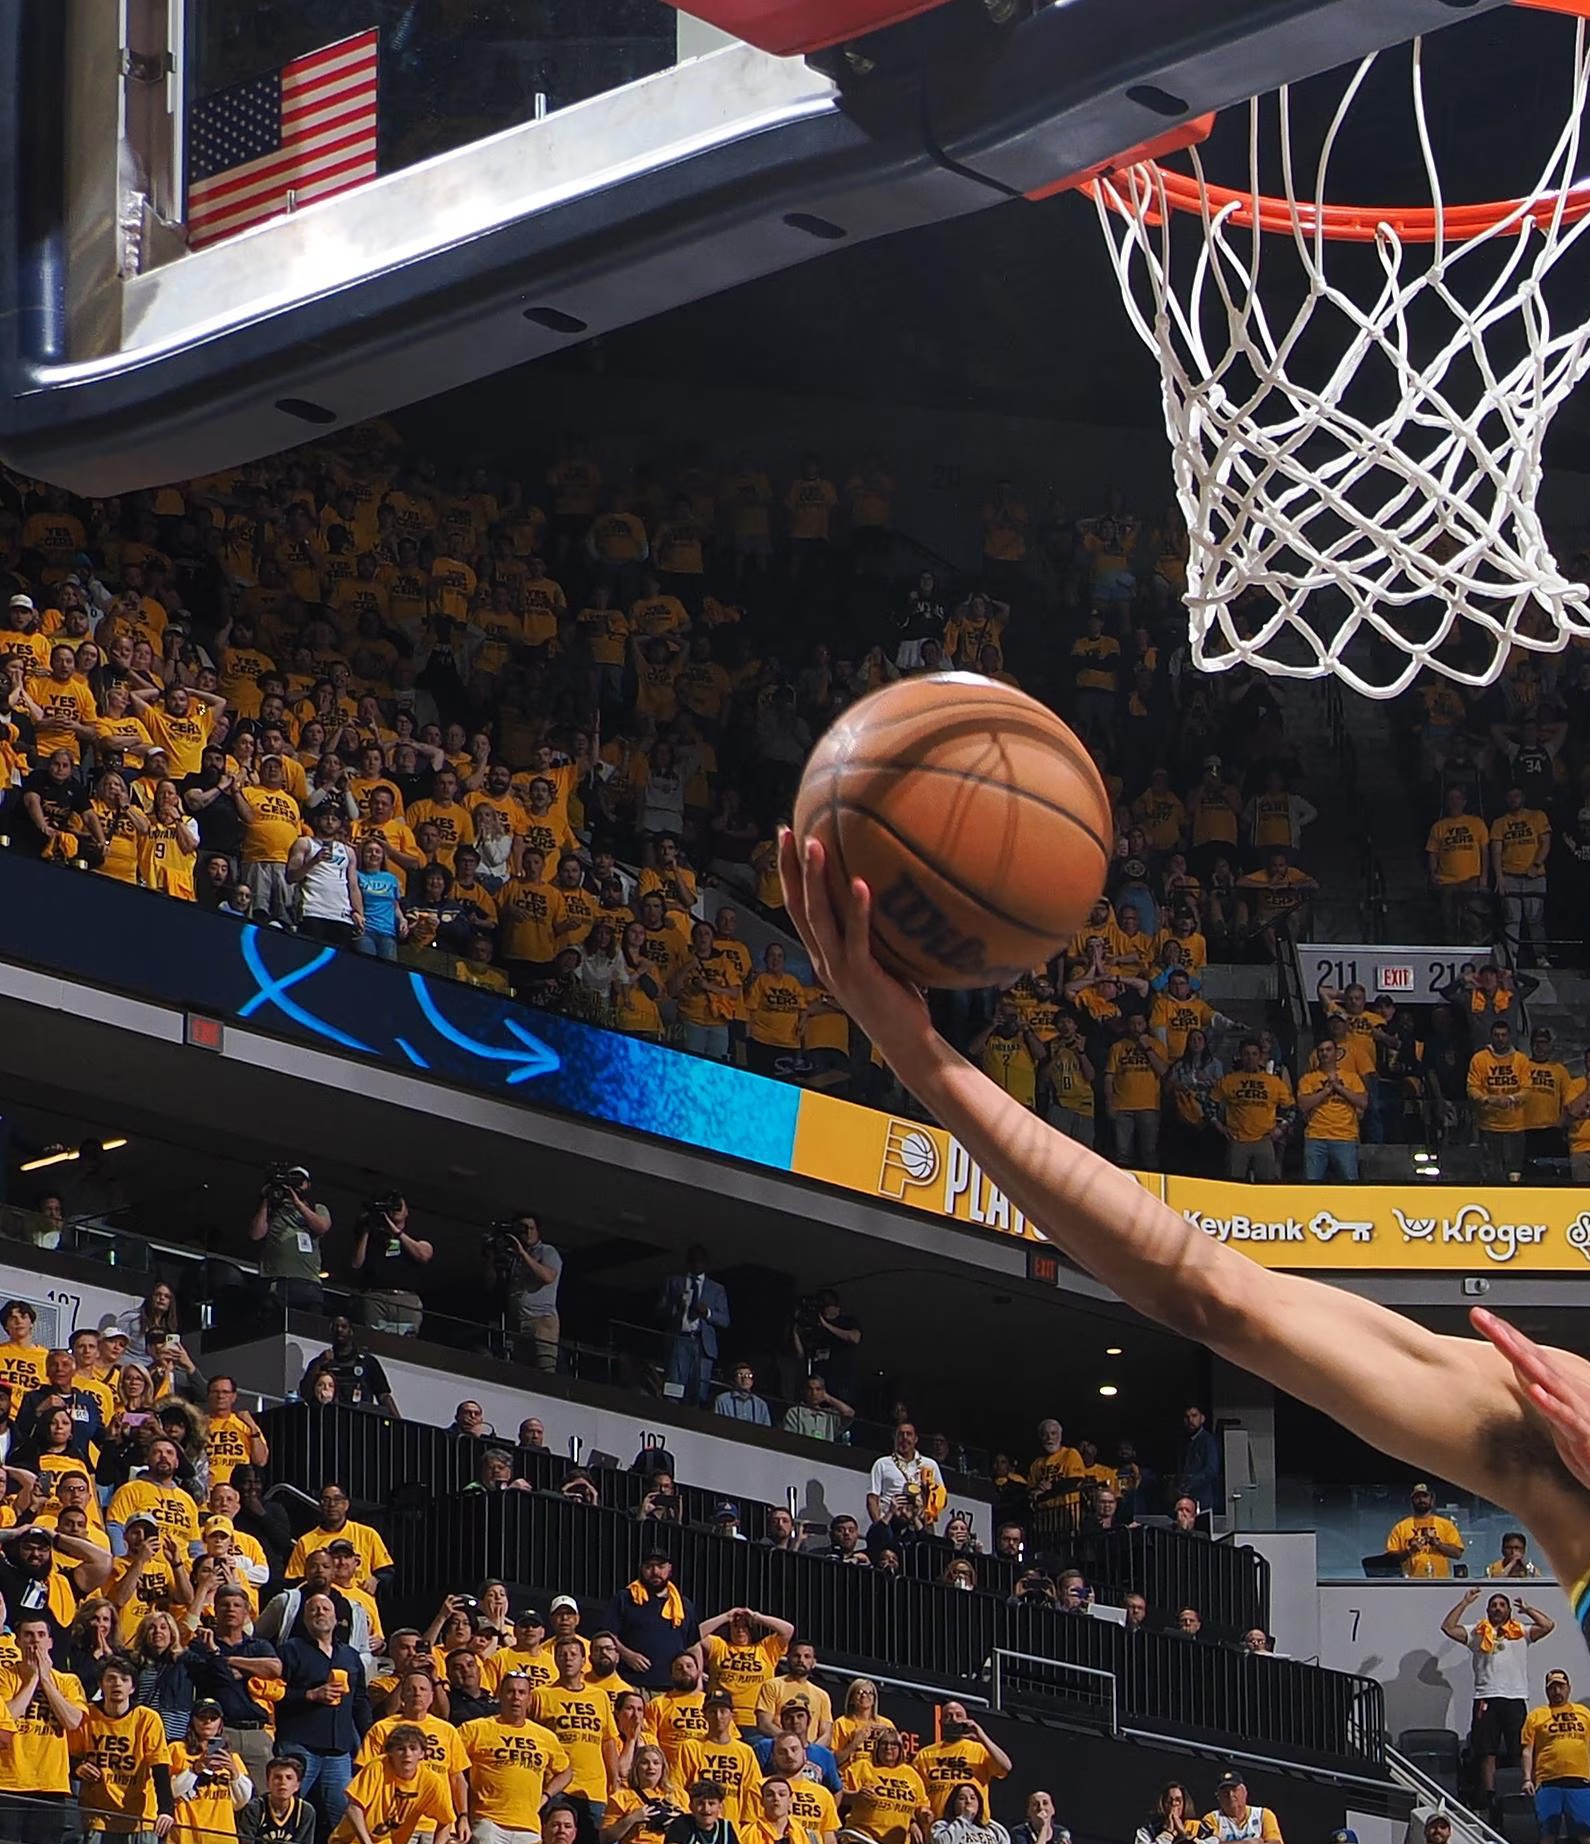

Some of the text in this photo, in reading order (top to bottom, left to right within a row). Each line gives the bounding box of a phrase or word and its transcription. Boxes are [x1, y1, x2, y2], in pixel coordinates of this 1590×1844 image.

[1317, 959, 1357, 992] 211
[1382, 967, 1409, 988] EXIT
[1183, 1209, 1304, 1242] KeyBank
[1442, 1204, 1546, 1262] Kroger
[1033, 1258, 1058, 1282] EXIT
[1348, 1609, 1361, 1642] 7
